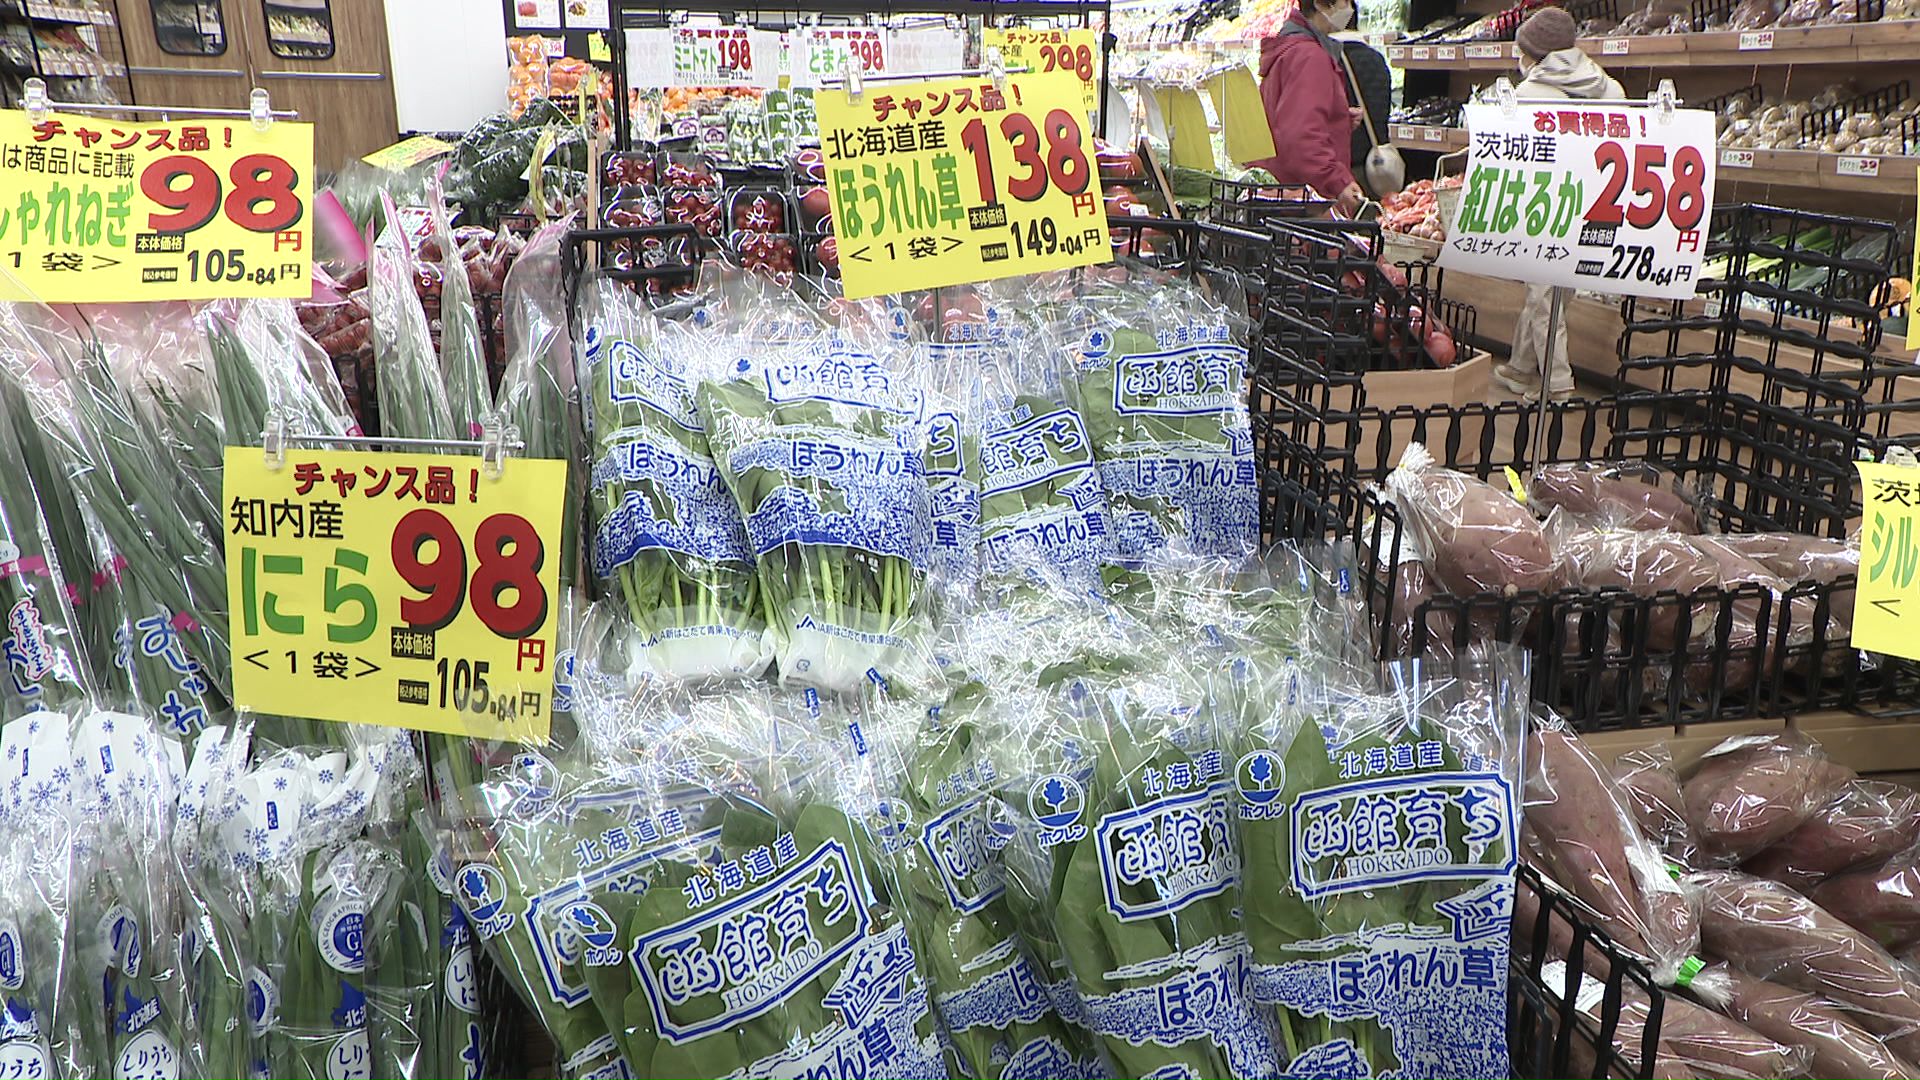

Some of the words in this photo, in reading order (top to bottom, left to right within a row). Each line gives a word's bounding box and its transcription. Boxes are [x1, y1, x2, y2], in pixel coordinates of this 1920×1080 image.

[675, 45, 717, 73] ミニトマト
[718, 39, 752, 70] 198
[873, 84, 1023, 122] チャンス品！
[32, 120, 233, 152] チャンス品！
[826, 119, 948, 160] 北海道産
[1533, 110, 1646, 138] お買得品！
[2, 143, 136, 180] は商品に記載
[1474, 131, 1557, 163] 茨城産
[833, 151, 965, 239] ほうれん草
[961, 107, 1091, 206] 138
[1073, 192, 1097, 218] 円
[0, 181, 136, 248] ゃれねぎ
[140, 153, 304, 233] 98
[274, 231, 302, 252] 円
[1457, 162, 1584, 239] 紅はるか
[1581, 140, 1706, 231] 258
[1677, 230, 1700, 252] 円
[970, 207, 1006, 227] 本体価格
[136, 235, 184, 251] 本体価格
[1580, 228, 1615, 246] 本体価格
[1157, 325, 1230, 349] 北海道産
[293, 462, 479, 505] チャンス品！
[984, 458, 1058, 490] HOKKAIDO
[1135, 457, 1256, 489] ほうれん草
[1871, 478, 1920, 508] 茨
[230, 496, 344, 540] 知内産
[933, 520, 959, 551] 草
[241, 546, 378, 645] にら
[391, 508, 549, 640] 98
[516, 637, 546, 673] 円
[391, 631, 434, 656] 本体価格
[1142, 750, 1224, 799] 北海道産
[1339, 741, 1445, 778] 北海道産
[936, 759, 997, 807] 北海道産
[1238, 804, 1285, 820] ホクレン
[1304, 786, 1502, 862] 函館育ち
[573, 806, 685, 868] 北海道産
[1038, 824, 1087, 848] ホクレン
[680, 832, 799, 909] 北海道産
[1170, 855, 1238, 897] HOKKADO
[1346, 847, 1450, 878] HOKKAIDO
[658, 867, 852, 1003] 函館育ち
[584, 948, 624, 968] ホクレン
[721, 939, 824, 1013] HOKKAIDO
[1330, 947, 1498, 1002] ほうれん草
[1011, 960, 1041, 1008] ほ
[123, 1043, 173, 1073] しりうち
